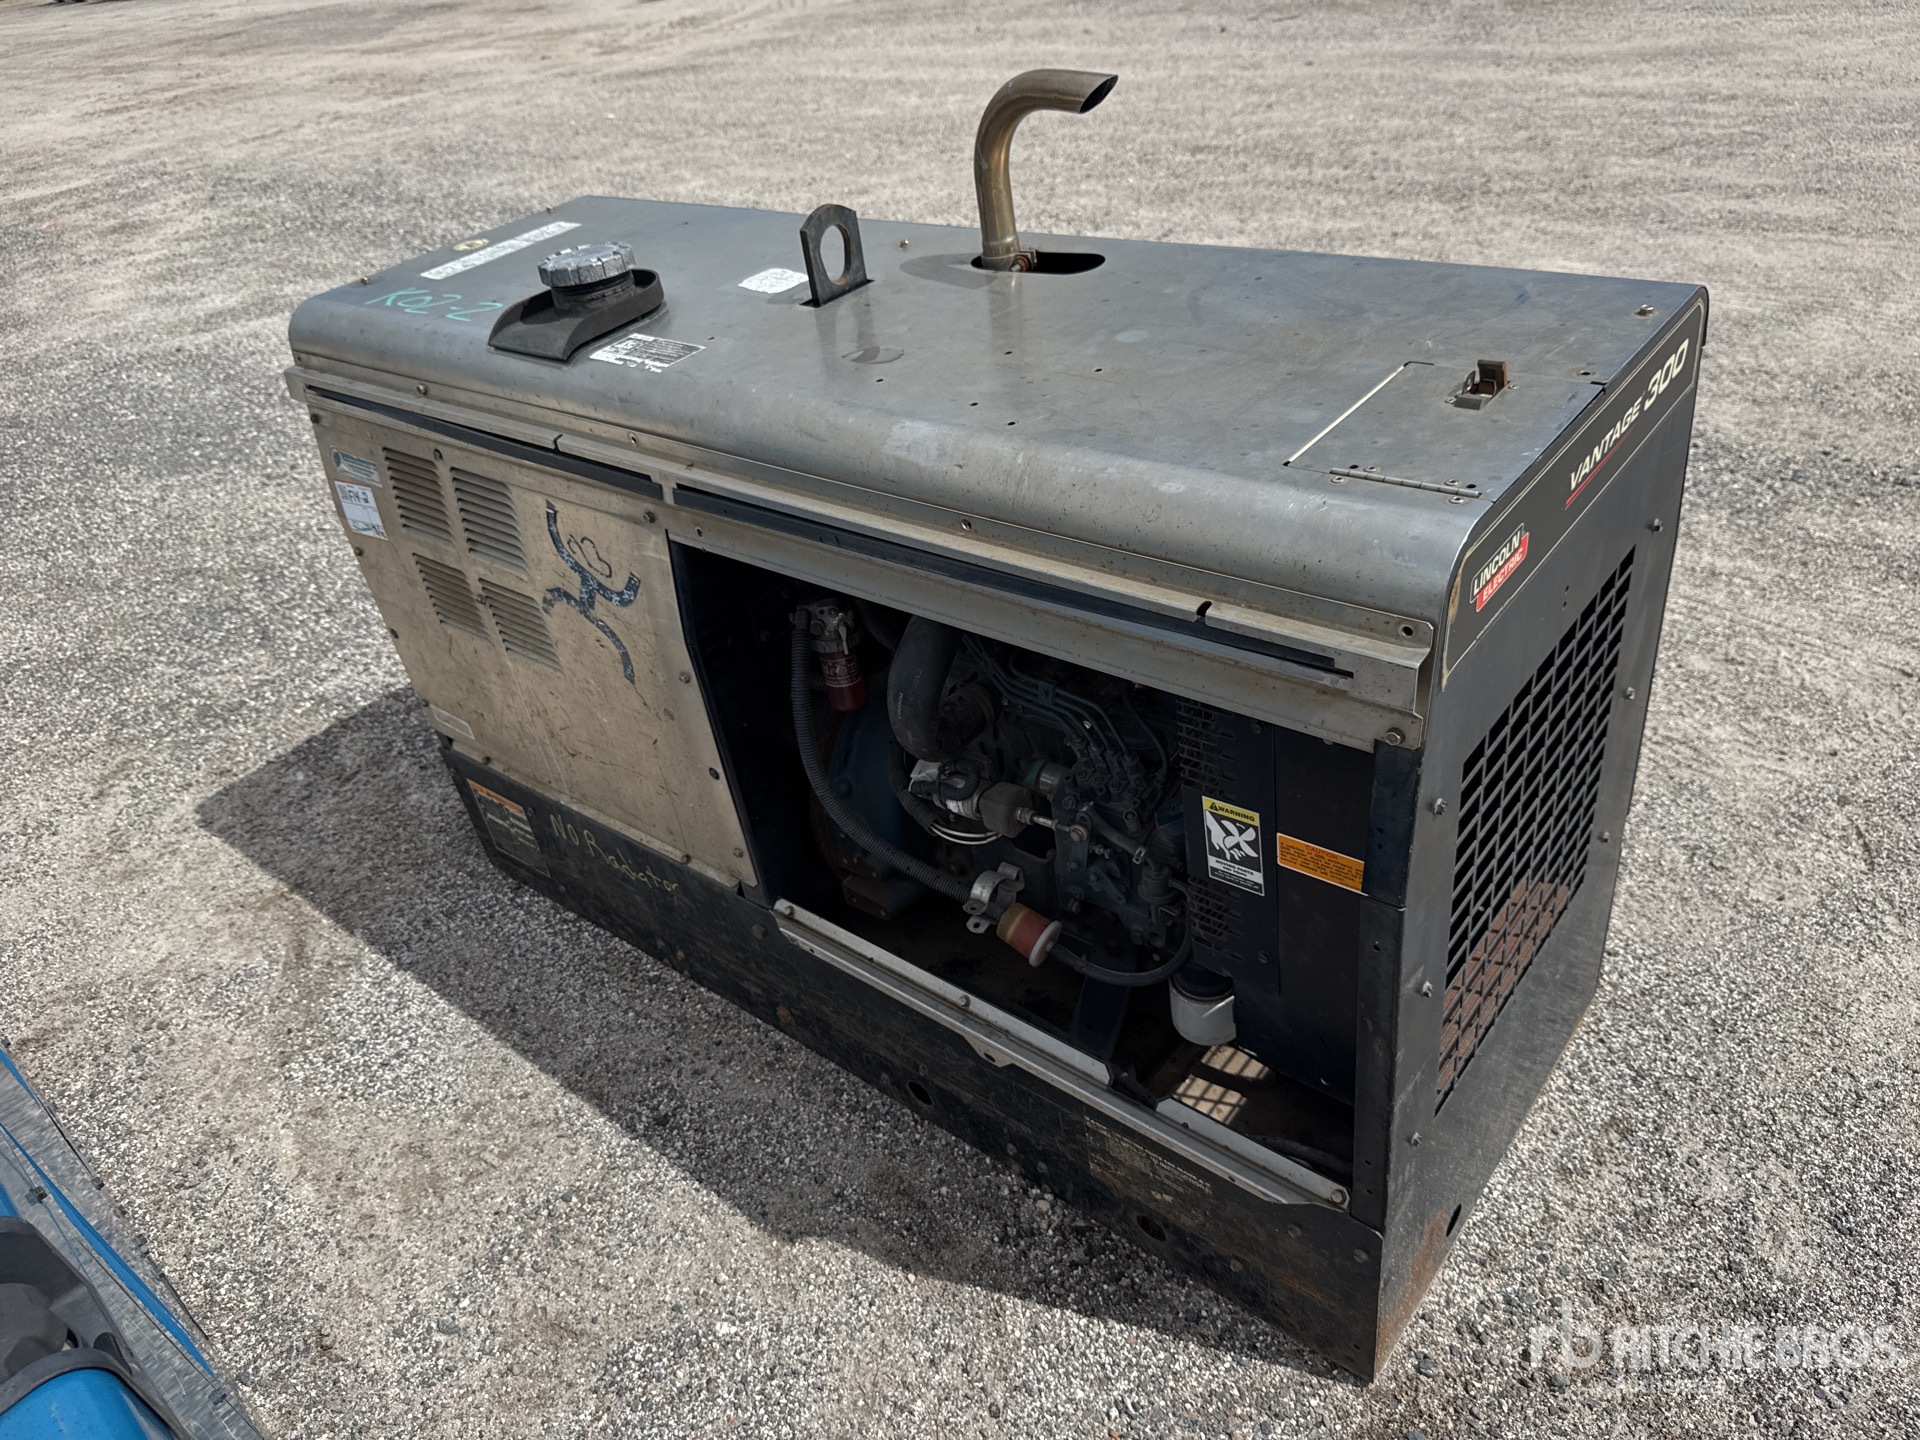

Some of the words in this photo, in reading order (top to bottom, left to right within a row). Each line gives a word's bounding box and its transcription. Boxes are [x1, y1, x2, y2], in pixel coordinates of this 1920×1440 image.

[1569, 396, 1643, 491] VANTAGE
[1644, 338, 1690, 411] 300
[1473, 530, 1521, 596] LINCOLN
[1482, 546, 1524, 602] ELECTRIC
[1218, 805, 1256, 822] WARNING
[1305, 845, 1339, 860] CAUTION
